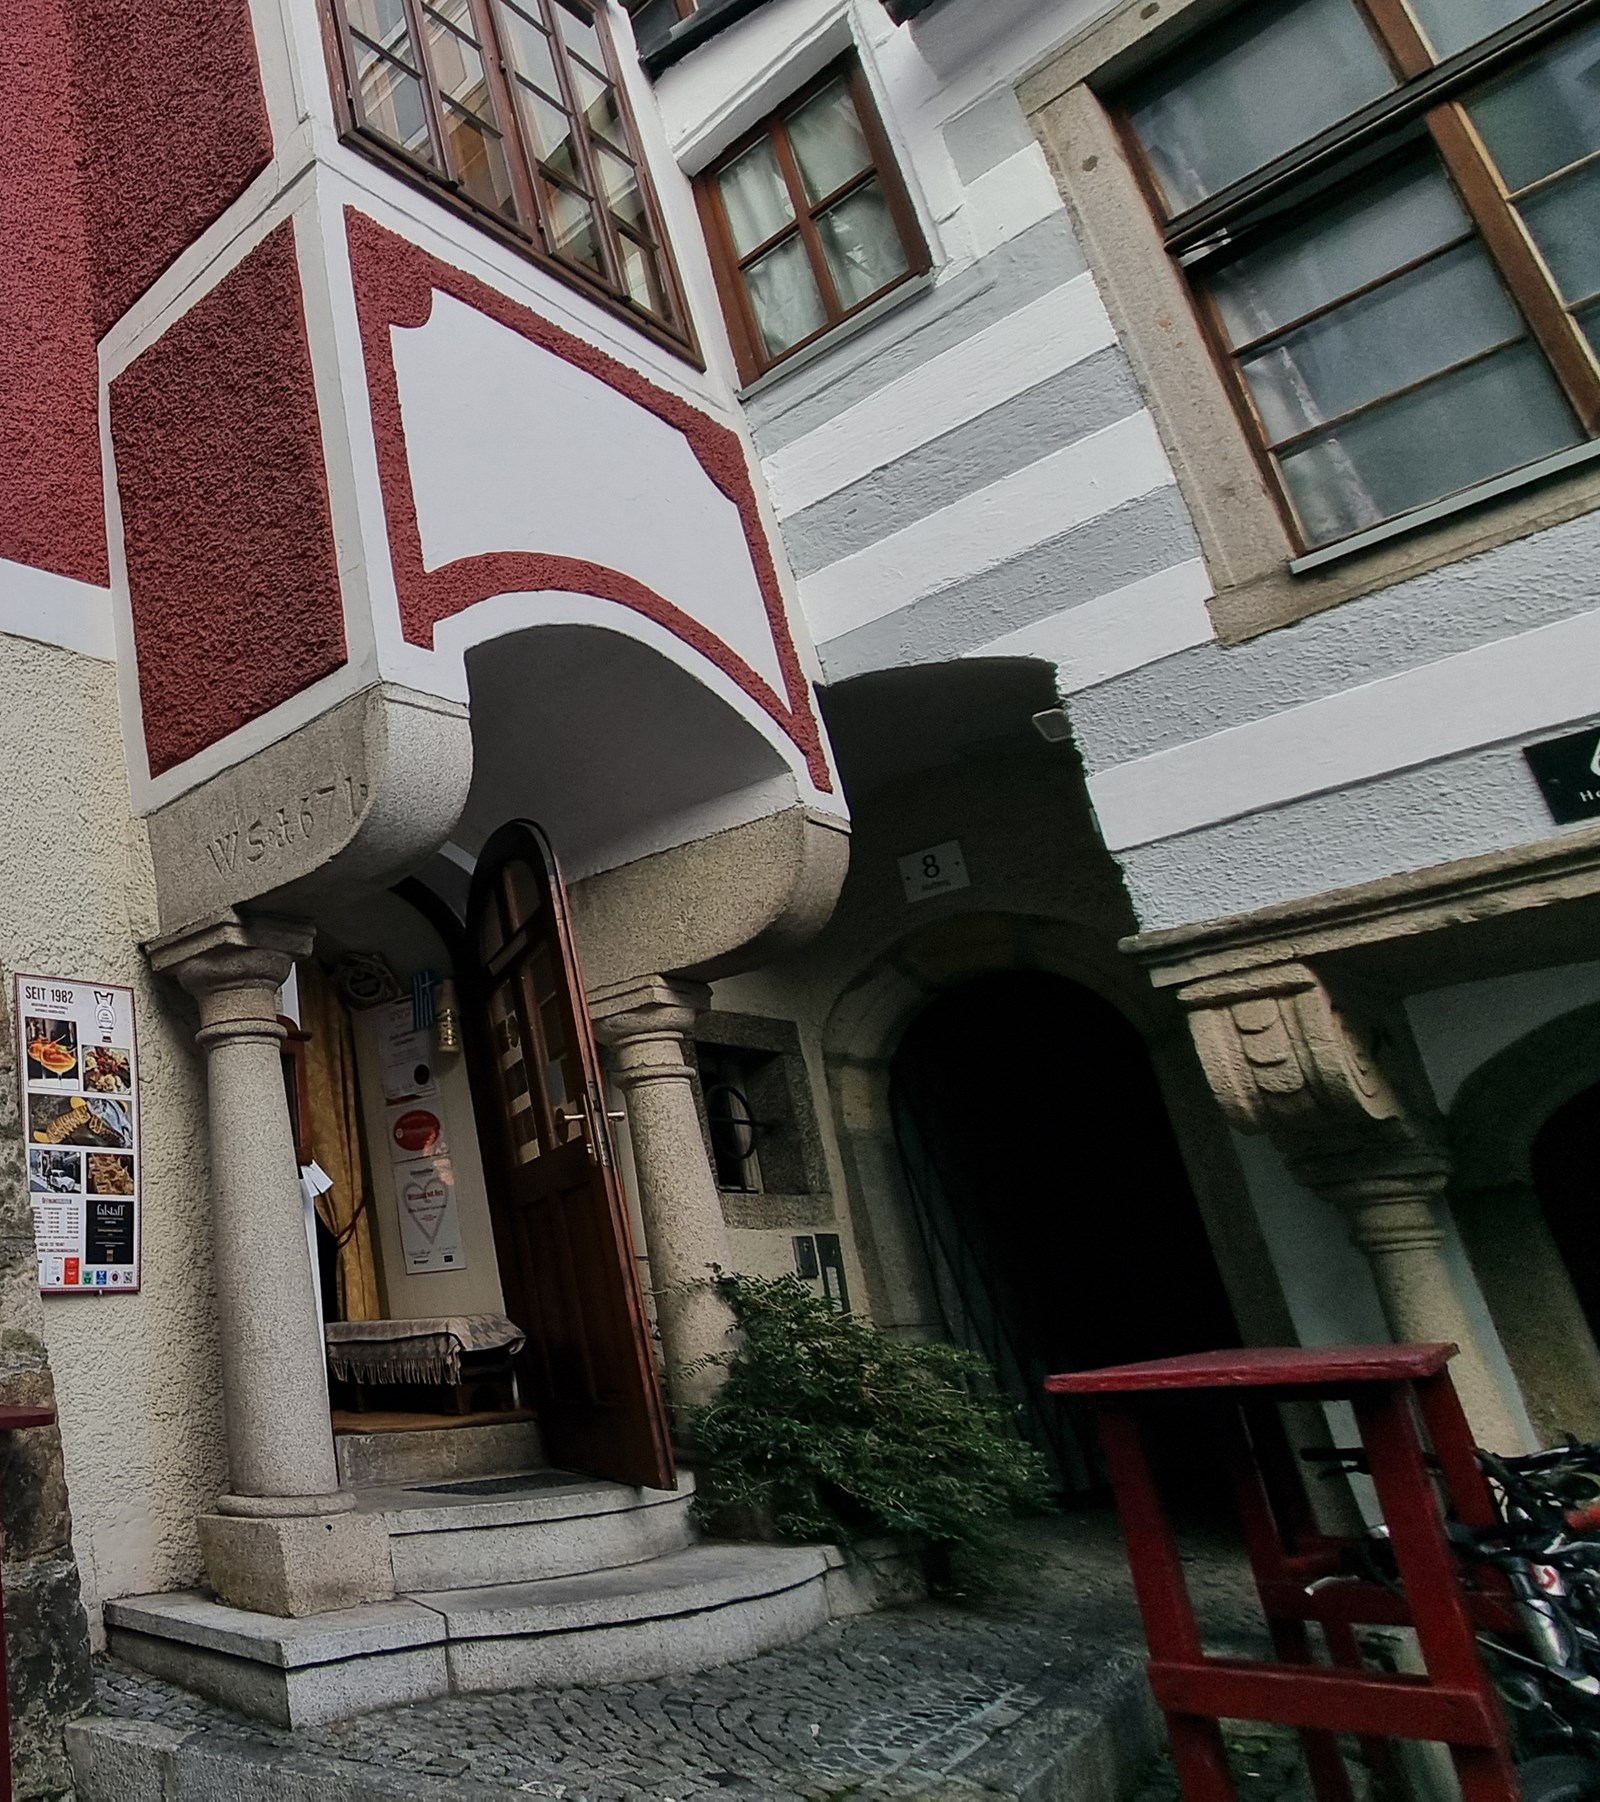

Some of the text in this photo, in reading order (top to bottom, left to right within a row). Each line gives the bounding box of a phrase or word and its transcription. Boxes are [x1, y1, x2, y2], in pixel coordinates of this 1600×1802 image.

[922, 854, 940, 878] 8
[25, 985, 74, 1004] SEIT 1982
